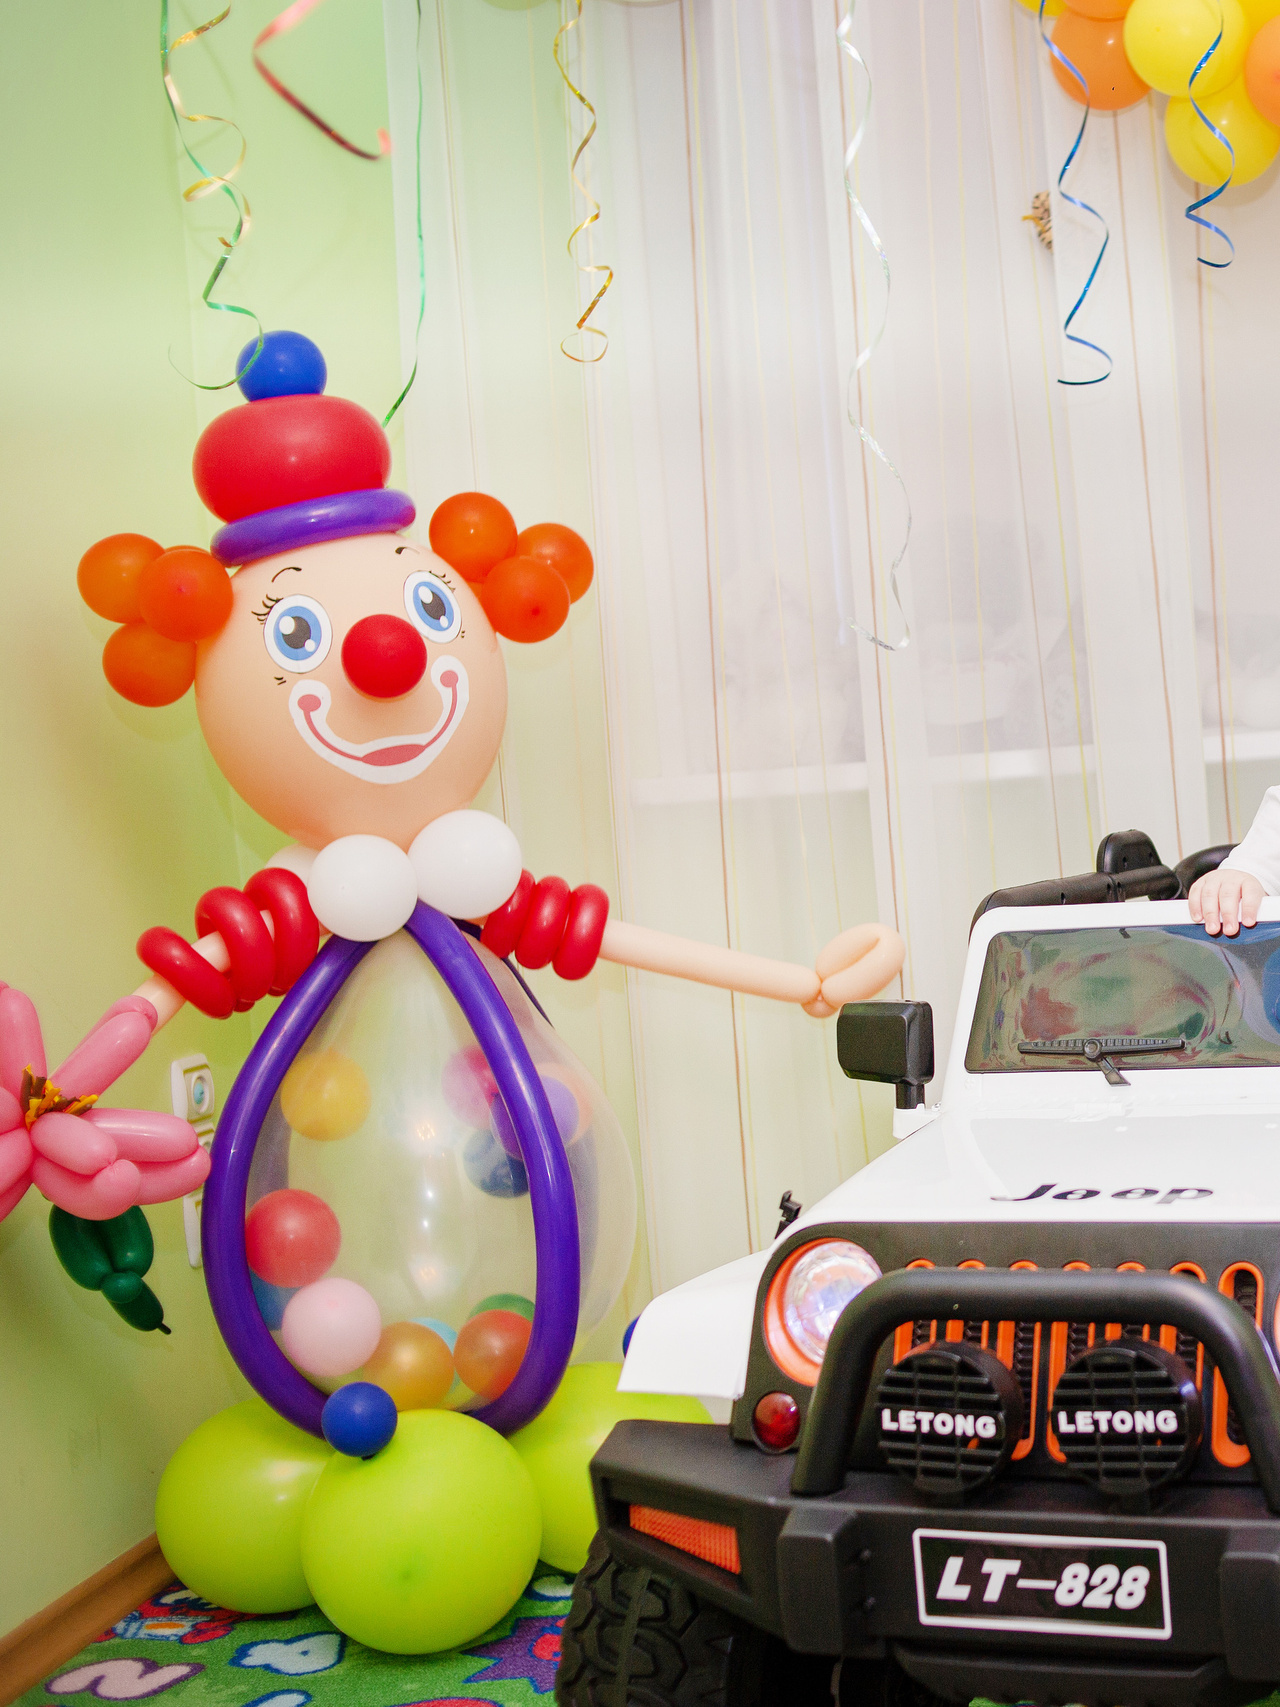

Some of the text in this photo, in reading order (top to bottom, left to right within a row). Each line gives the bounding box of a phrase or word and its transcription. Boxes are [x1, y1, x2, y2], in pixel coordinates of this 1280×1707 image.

[881, 1408, 997, 1438] LETONG
[1057, 1409, 1178, 1434] LETONG
[936, 1556, 1150, 1610] LT-828
